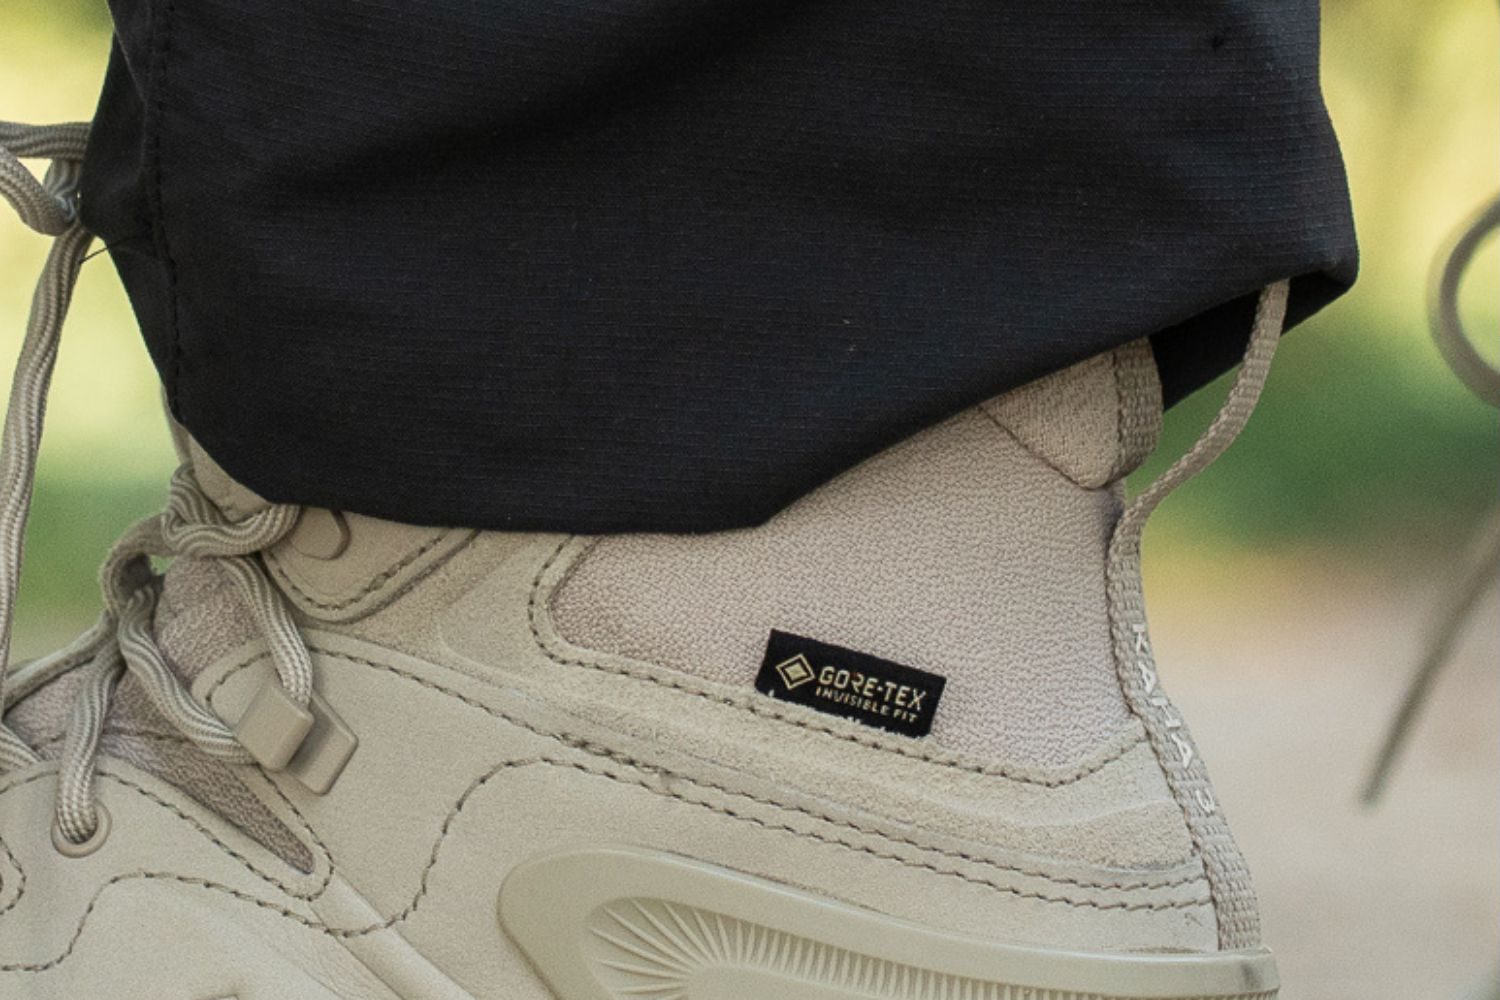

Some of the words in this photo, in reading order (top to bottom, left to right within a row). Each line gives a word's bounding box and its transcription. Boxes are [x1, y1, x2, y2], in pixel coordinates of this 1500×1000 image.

[815, 686, 890, 716] INVISIBLE
[893, 708, 918, 723] FIT
[1131, 623, 1193, 769] KAHA
